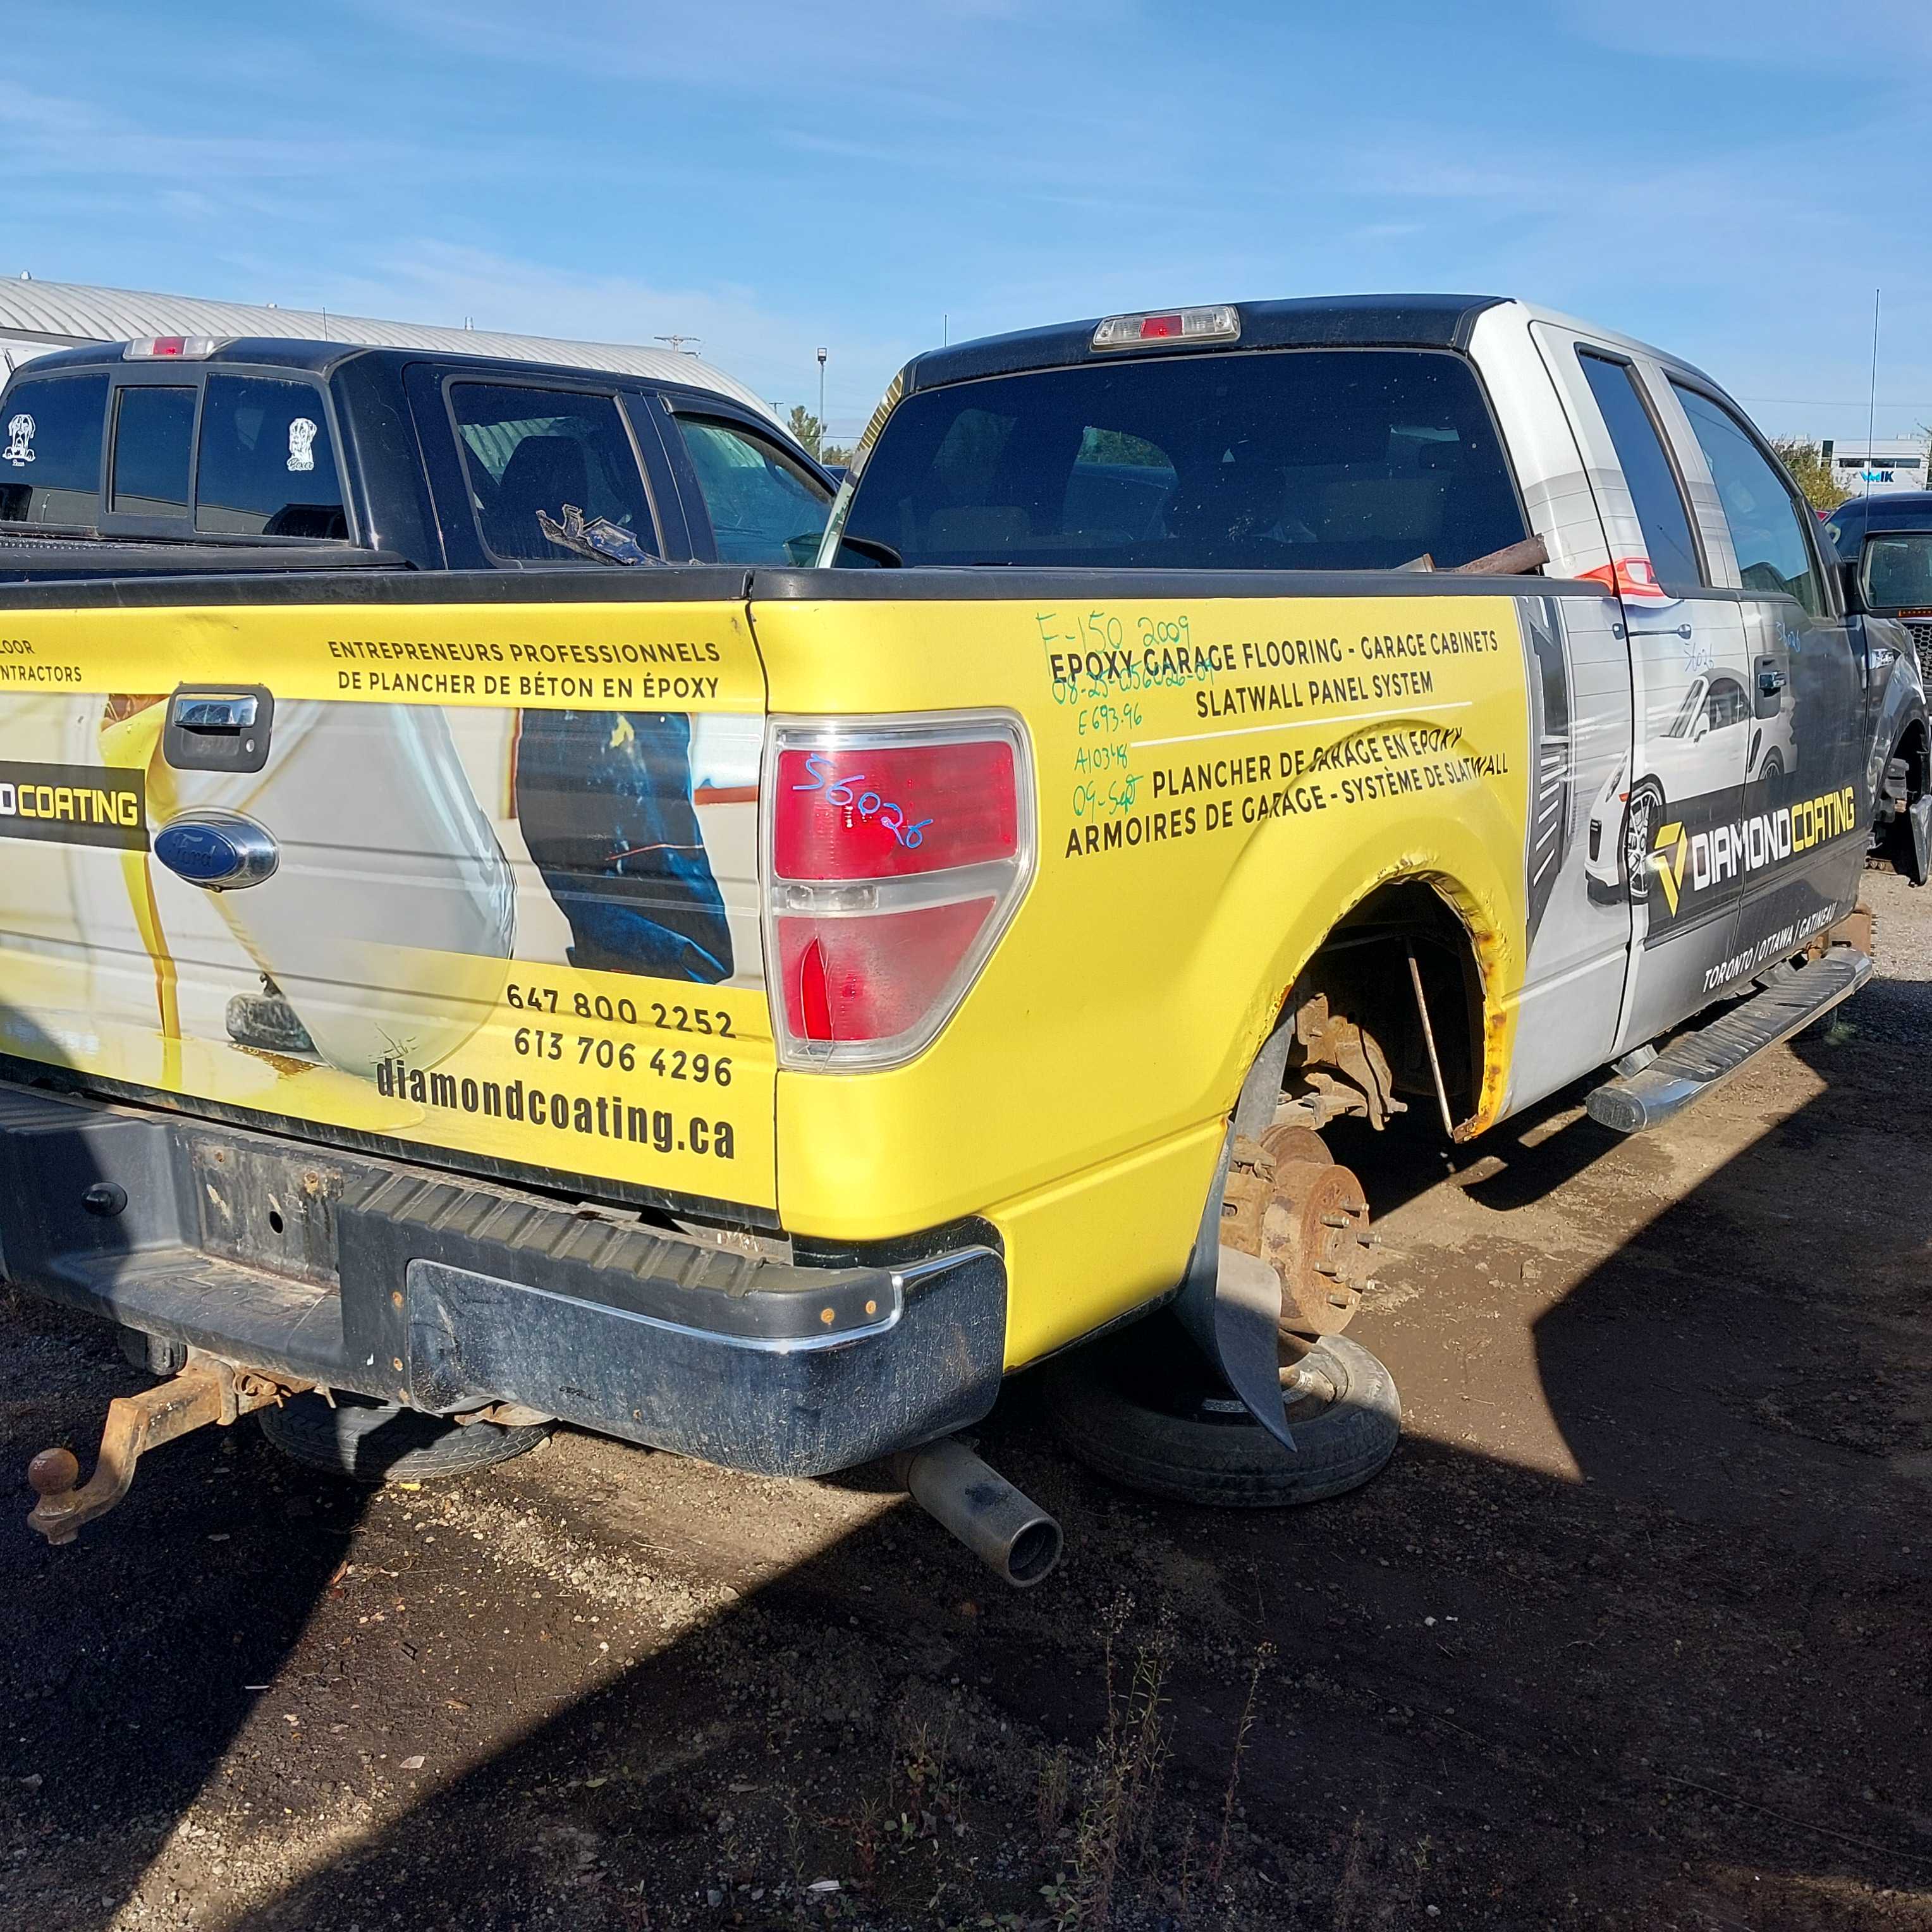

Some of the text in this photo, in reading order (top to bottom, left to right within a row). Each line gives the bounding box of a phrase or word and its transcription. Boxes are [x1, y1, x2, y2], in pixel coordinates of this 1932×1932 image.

[327, 641, 721, 664] ENTREPRENEURS PROFESSIONNELS
[1036, 611, 1190, 676] F-150 2009
[1050, 649, 1133, 683] EPOXY
[1144, 644, 1237, 677] GARAGE
[1242, 637, 1343, 669] FLOORING
[1360, 633, 1428, 660] GARAGE
[1429, 630, 1498, 656] CABINETS
[0, 665, 82, 682] NTRACTORS
[338, 670, 719, 699] DE PLANCHER DE BÉTON EN ÉPOXY
[1195, 671, 1434, 718] SLATWALL PANEL SYSTEM
[1152, 755, 1272, 799] PLANCHER
[1280, 750, 1305, 778] DE
[1382, 733, 1410, 760] EN
[1065, 806, 1197, 859] ARMOIRES
[1205, 800, 1233, 832] DE
[1242, 785, 1327, 824] GARAGE
[1341, 766, 1423, 804] SYSTÈME
[1422, 764, 1446, 788] DE
[1444, 752, 1509, 785] SLATWALL
[1703, 947, 1754, 993] TORONTO
[1758, 925, 1794, 962] OTTAWA
[1799, 902, 1838, 939] GATINEAU
[506, 984, 737, 1039] 647 800 2252
[515, 1027, 733, 1087] 613 706 4296
[376, 1058, 735, 1159] diamondcoating.ca
